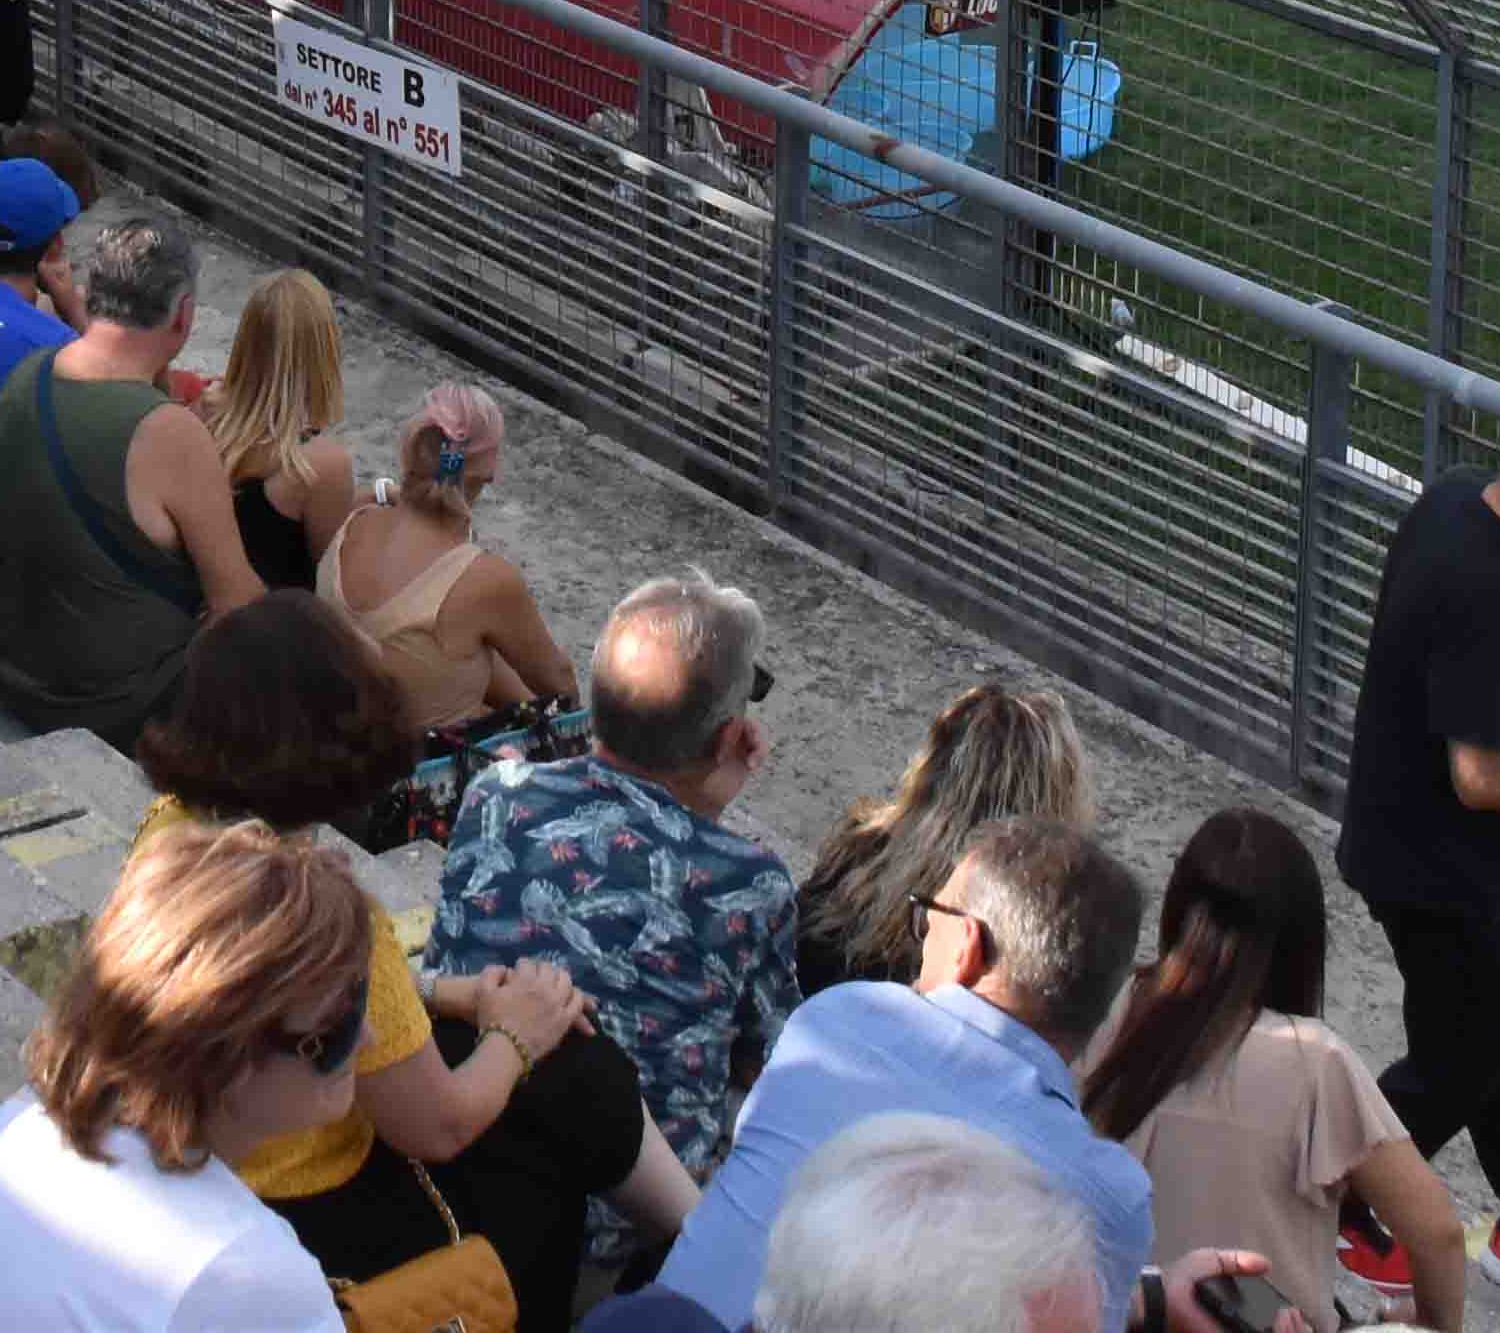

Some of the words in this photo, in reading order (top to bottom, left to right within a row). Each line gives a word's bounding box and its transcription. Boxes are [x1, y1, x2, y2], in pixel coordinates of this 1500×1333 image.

[296, 42, 382, 94] SETTORE
[403, 68, 425, 108] B
[284, 79, 301, 103] dal
[323, 87, 357, 127] 345
[363, 107, 380, 136] al
[414, 123, 450, 164] 551
